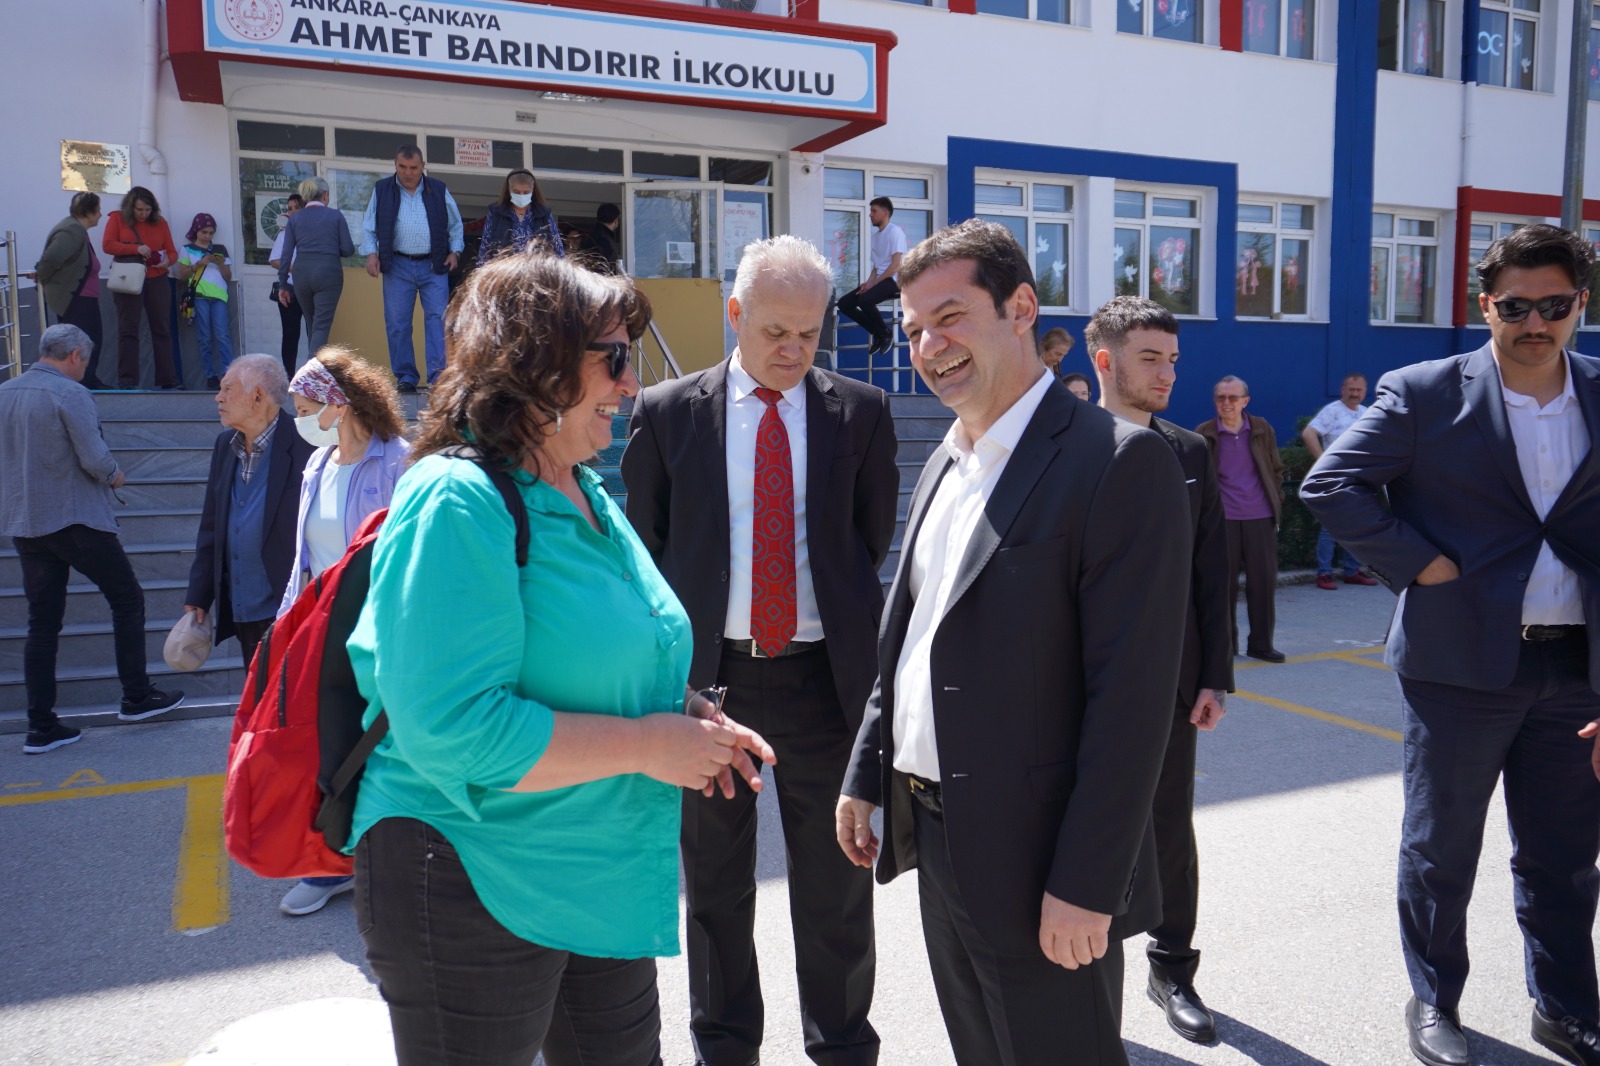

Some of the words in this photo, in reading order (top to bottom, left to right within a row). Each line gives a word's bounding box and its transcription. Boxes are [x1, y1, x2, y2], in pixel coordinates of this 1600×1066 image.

[290, 17, 433, 57] AHMET
[447, 34, 660, 80] BARINDIRIR
[673, 50, 835, 96] İLKOKULU
